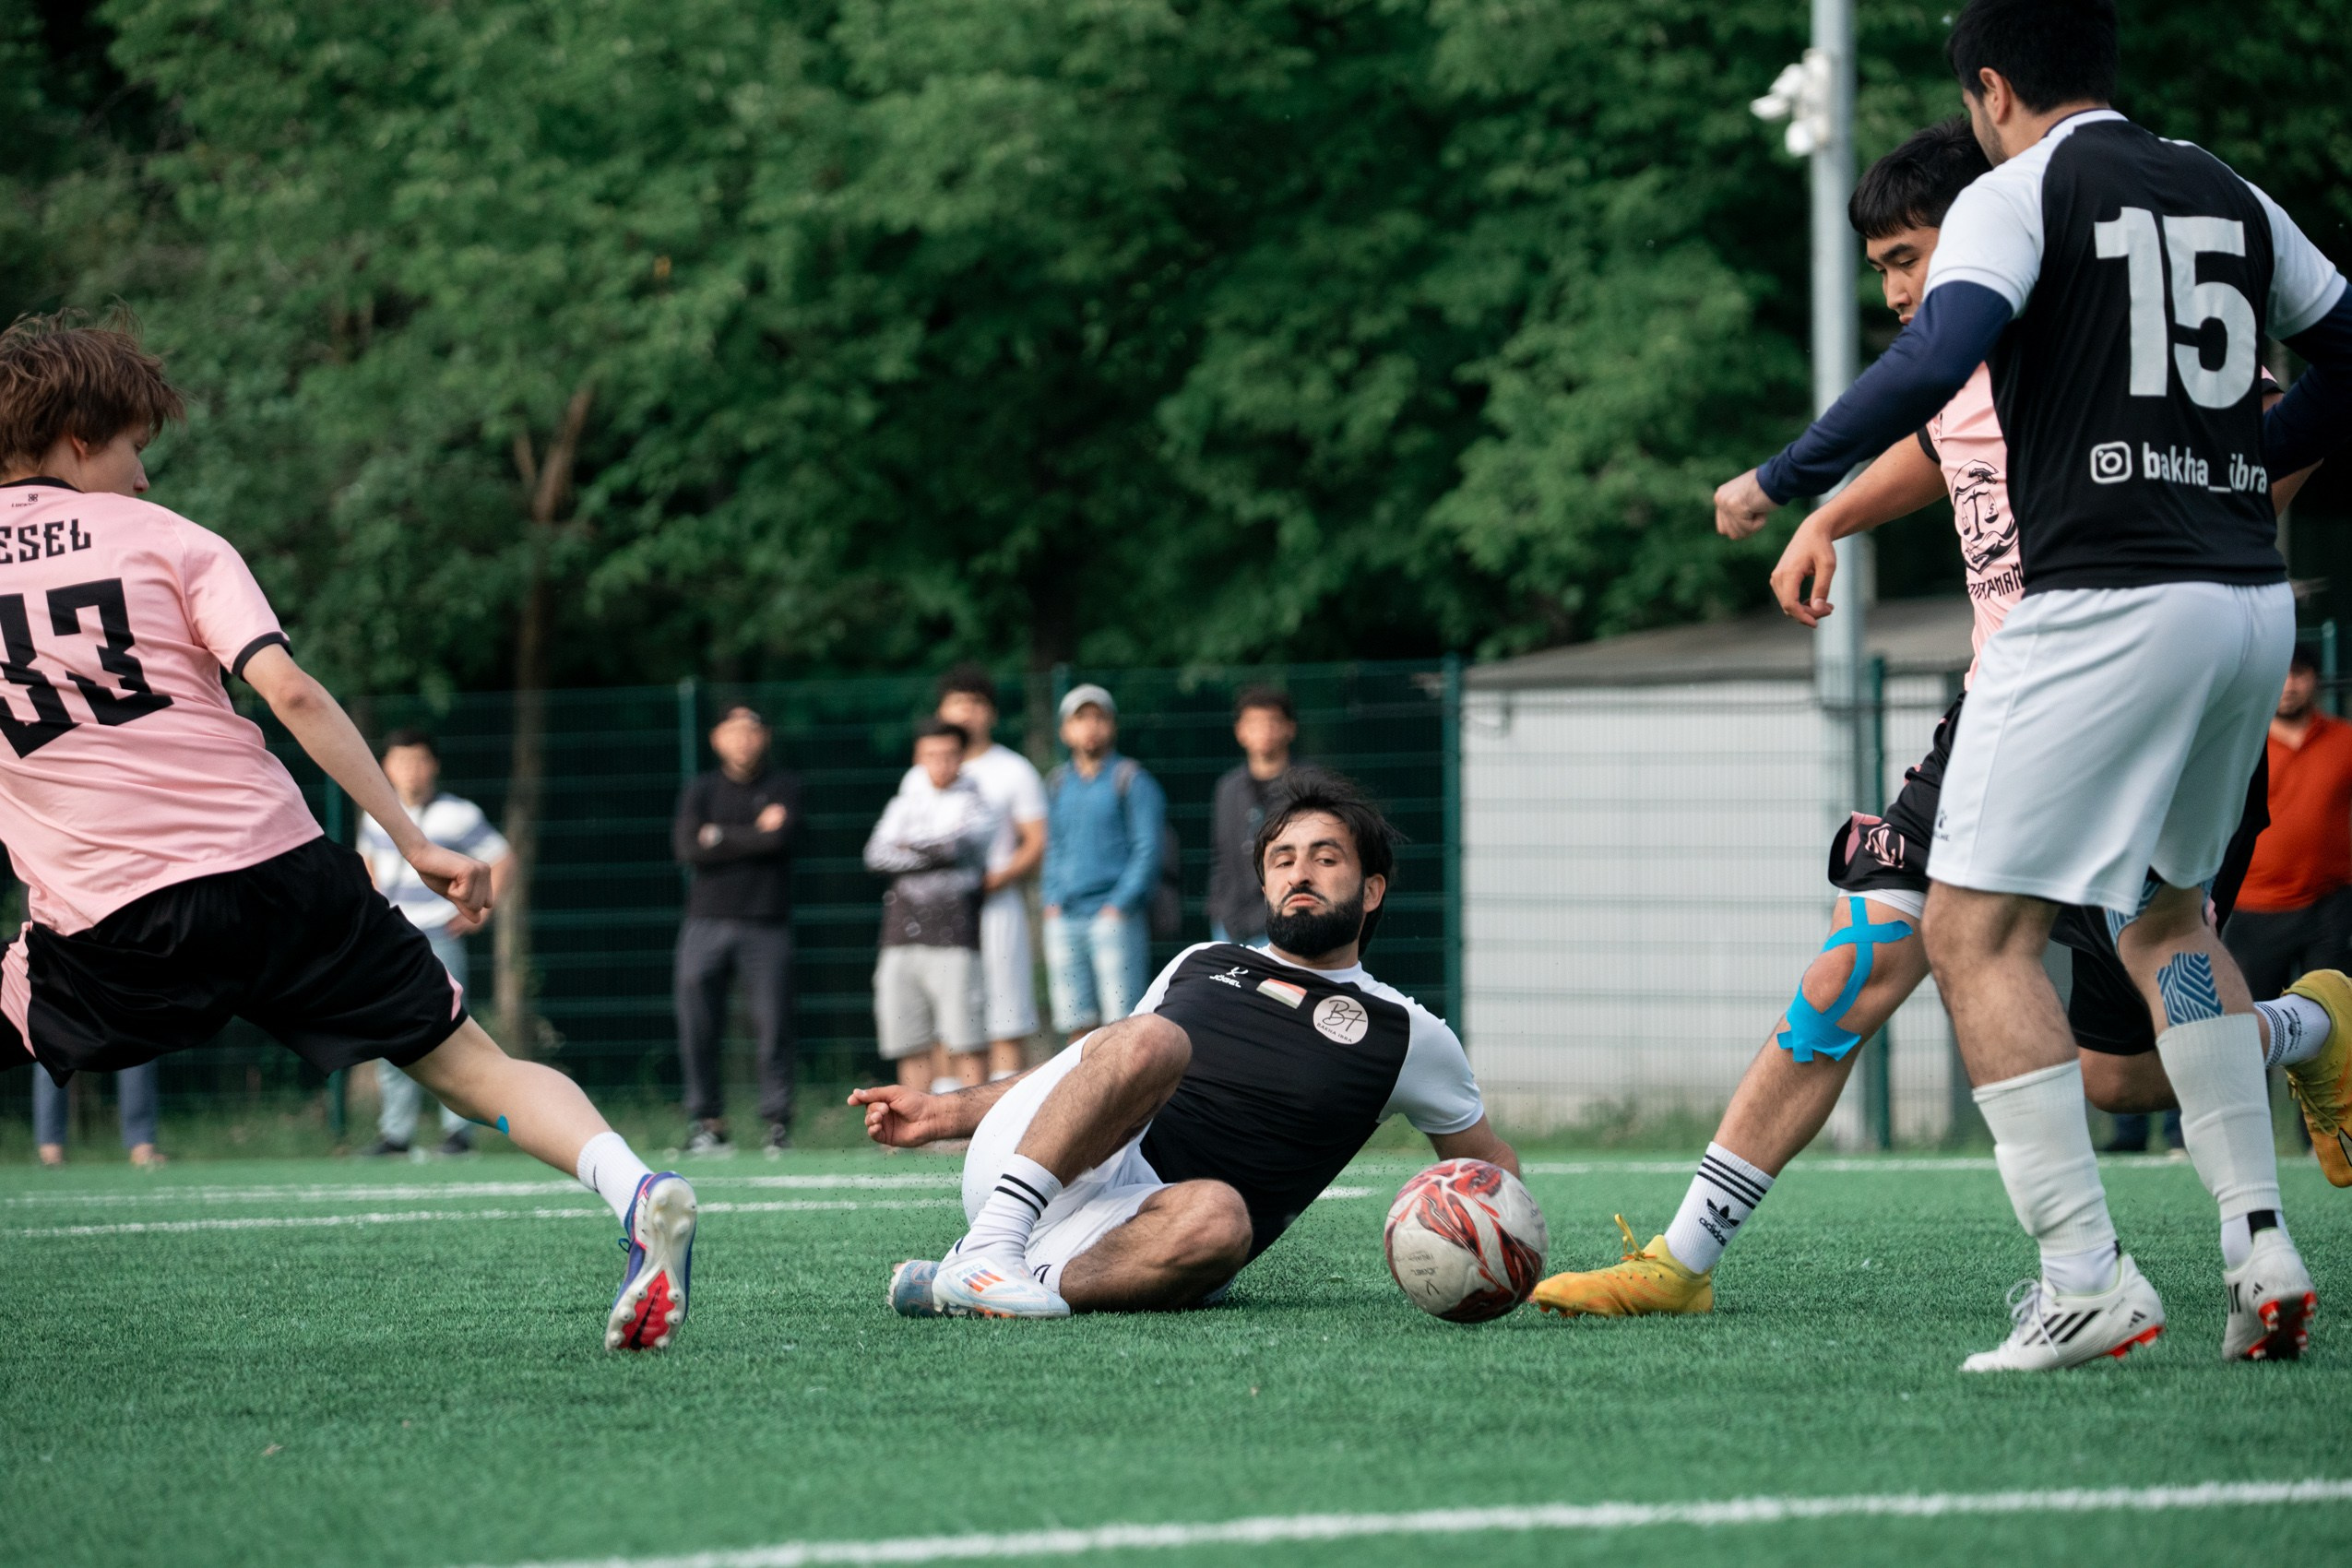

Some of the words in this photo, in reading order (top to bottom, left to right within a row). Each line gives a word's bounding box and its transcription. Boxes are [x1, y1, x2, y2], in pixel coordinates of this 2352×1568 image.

[2094, 206, 2257, 409] 15
[2142, 441, 2269, 495] bakha_ibra
[1322, 999, 1367, 1032] B7
[1699, 1217, 1728, 1246] adidas
